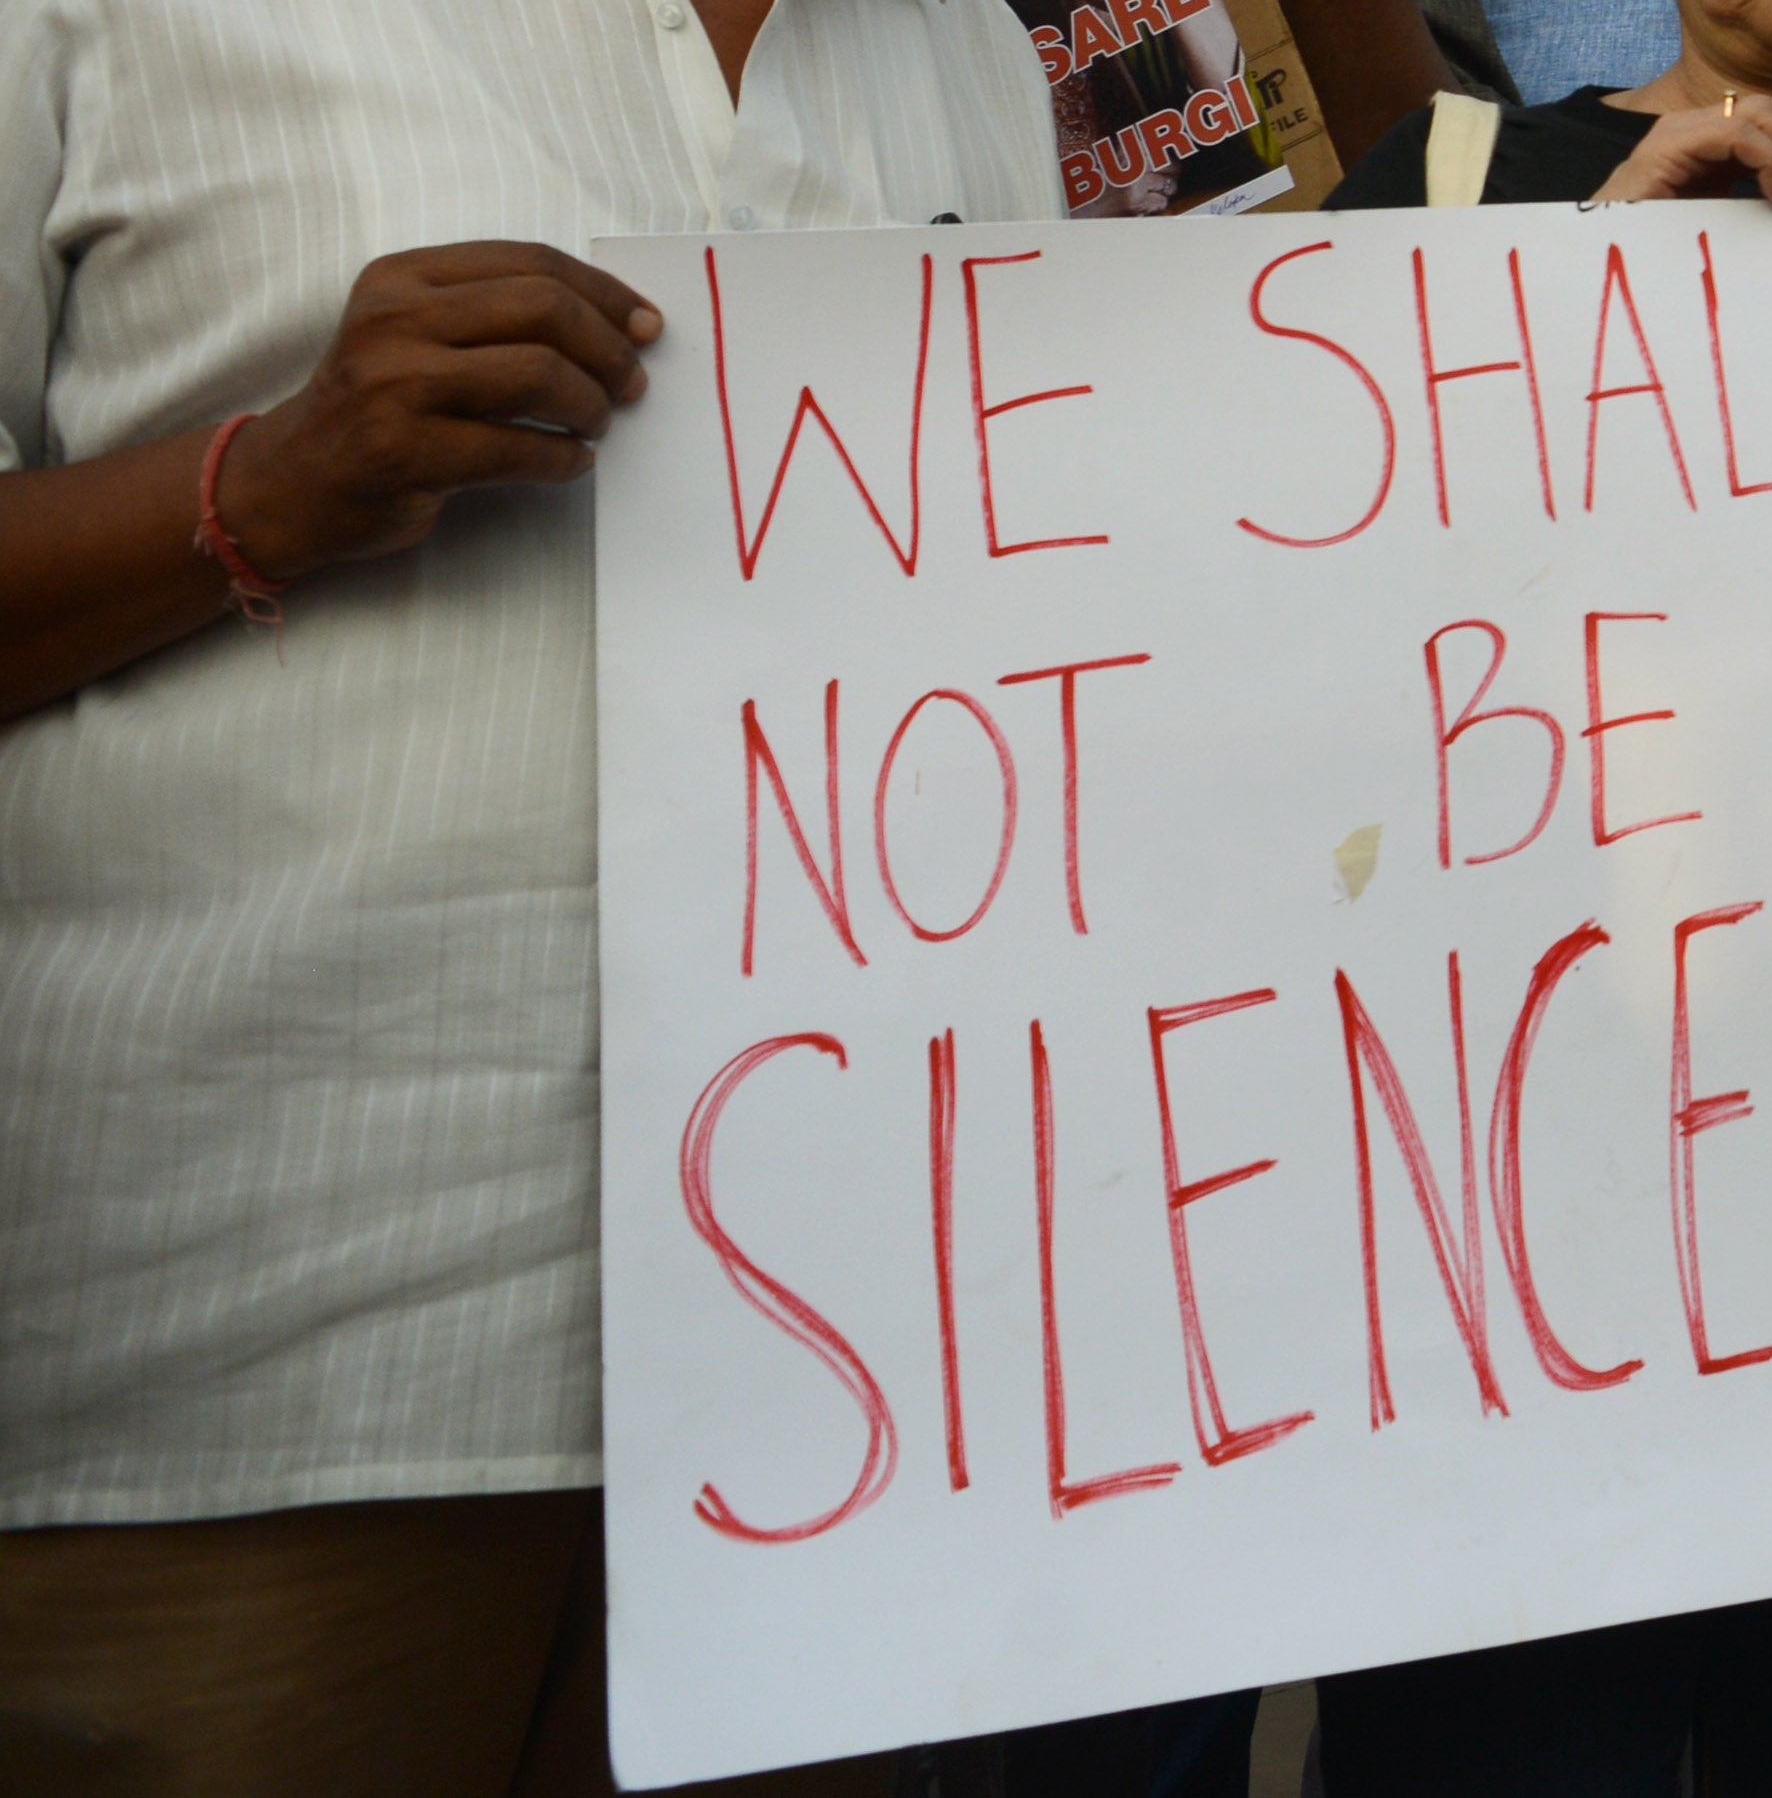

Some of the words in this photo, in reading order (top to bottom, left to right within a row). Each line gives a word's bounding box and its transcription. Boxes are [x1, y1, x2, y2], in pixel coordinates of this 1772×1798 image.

[1061, 75, 1259, 208] BURGI
[706, 246, 1109, 579] WE
[743, 652, 1151, 976] NOT
[1422, 611, 1703, 870] BE
